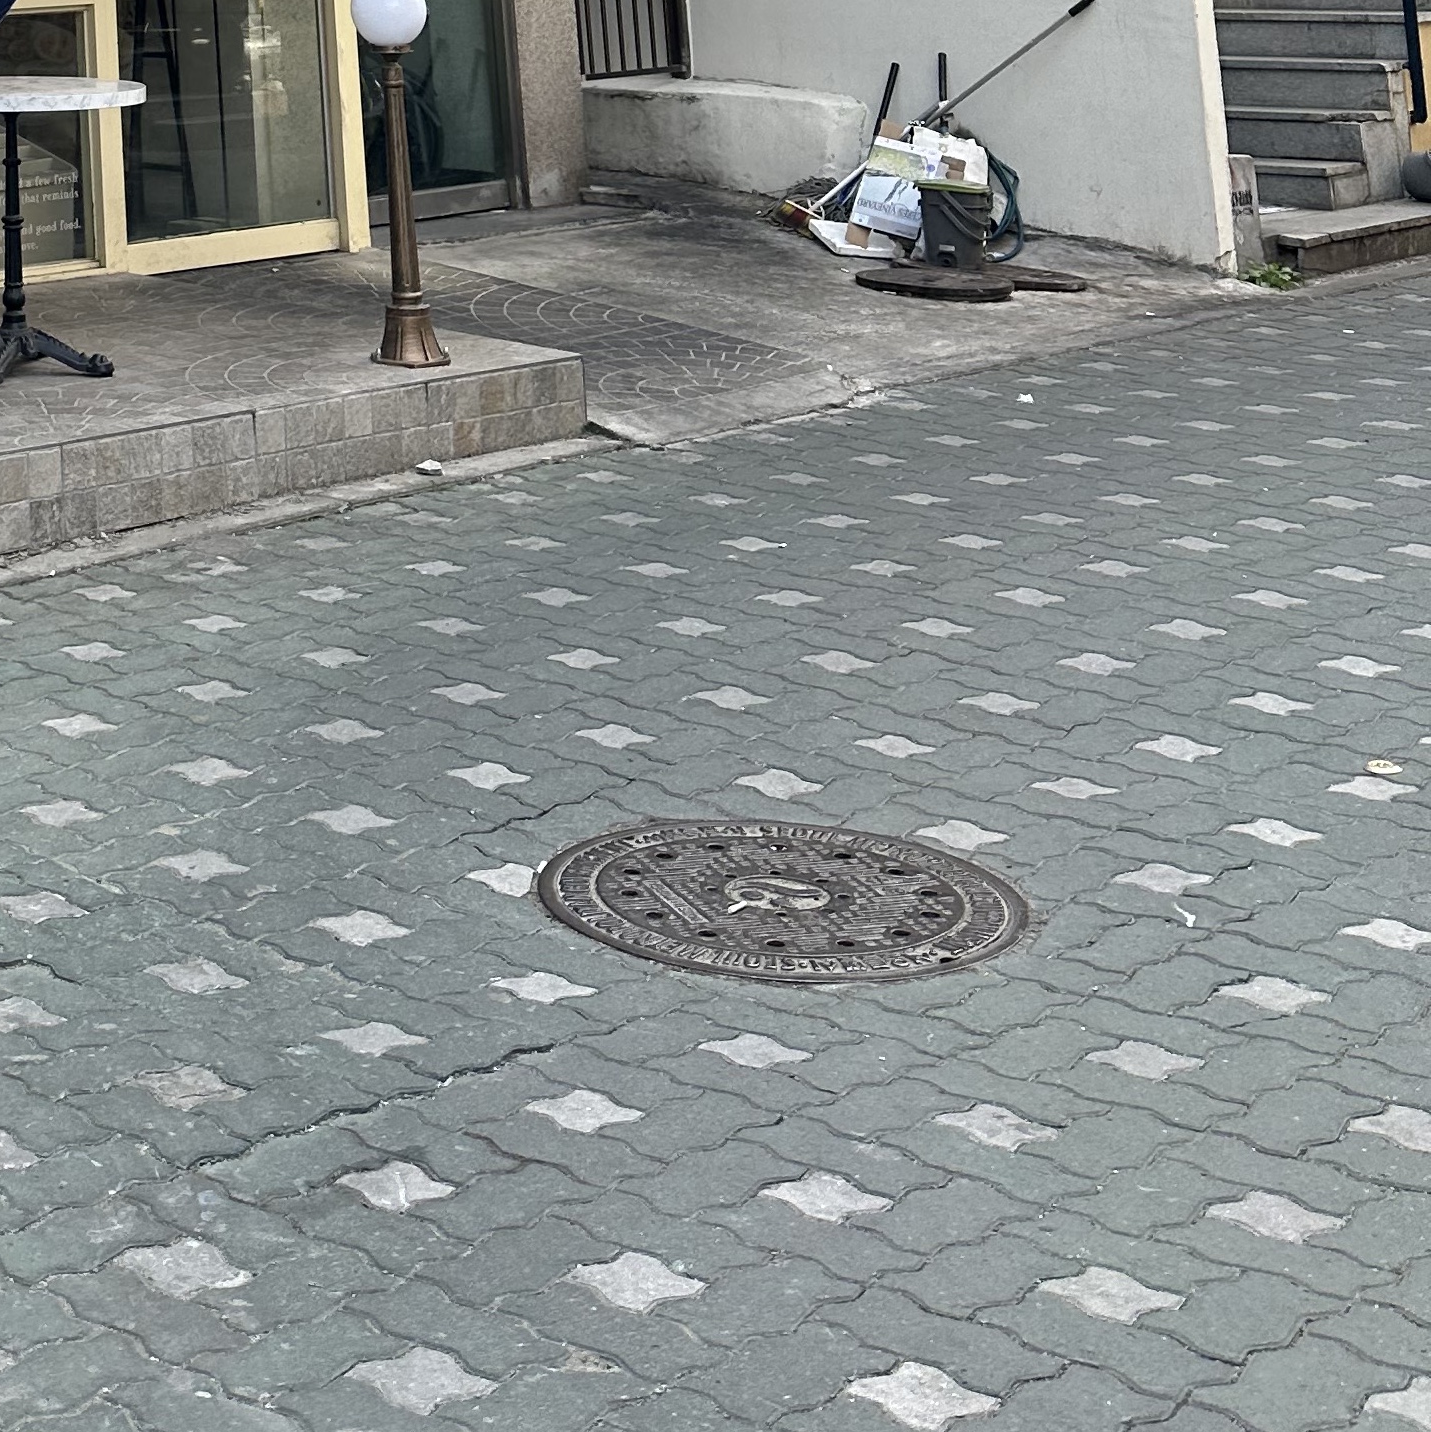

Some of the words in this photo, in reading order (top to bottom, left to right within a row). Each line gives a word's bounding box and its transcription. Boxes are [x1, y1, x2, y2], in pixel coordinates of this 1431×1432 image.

[54, 171, 79, 185] fresh
[42, 187, 80, 202] reminds
[35, 220, 58, 236] good
